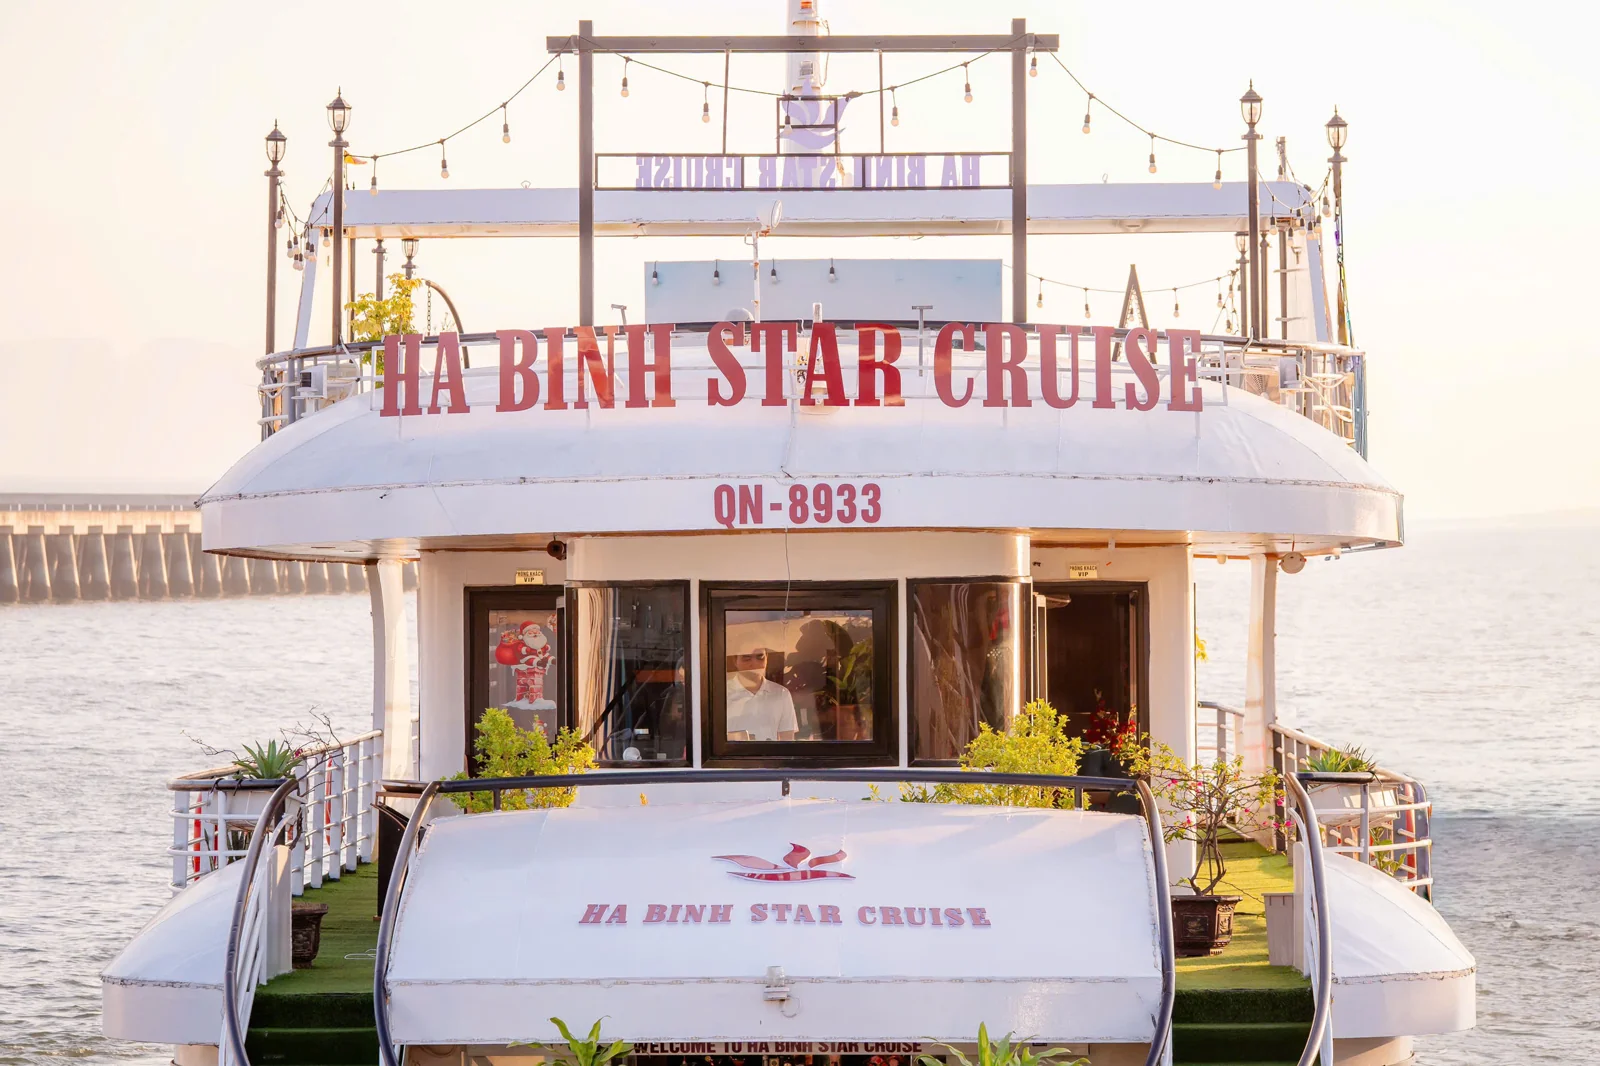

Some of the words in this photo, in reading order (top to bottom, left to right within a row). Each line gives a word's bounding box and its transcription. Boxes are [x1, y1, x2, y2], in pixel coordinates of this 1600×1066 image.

[380, 331, 470, 417] HA
[495, 323, 676, 412] BINH
[707, 321, 906, 407] STAR
[933, 322, 1203, 412] CRUISE
[713, 483, 882, 530] QN-8933
[578, 904, 628, 925] HA
[643, 904, 734, 925] BINH
[750, 903, 843, 924] STAR
[858, 906, 992, 926] CRUISE
[633, 1042, 716, 1054] WELCOME
[722, 1042, 742, 1054] TO
[747, 1042, 770, 1053] HA
[774, 1042, 813, 1053] BINH
[818, 1042, 859, 1053] STAR
[864, 1042, 922, 1053] CRUISE
